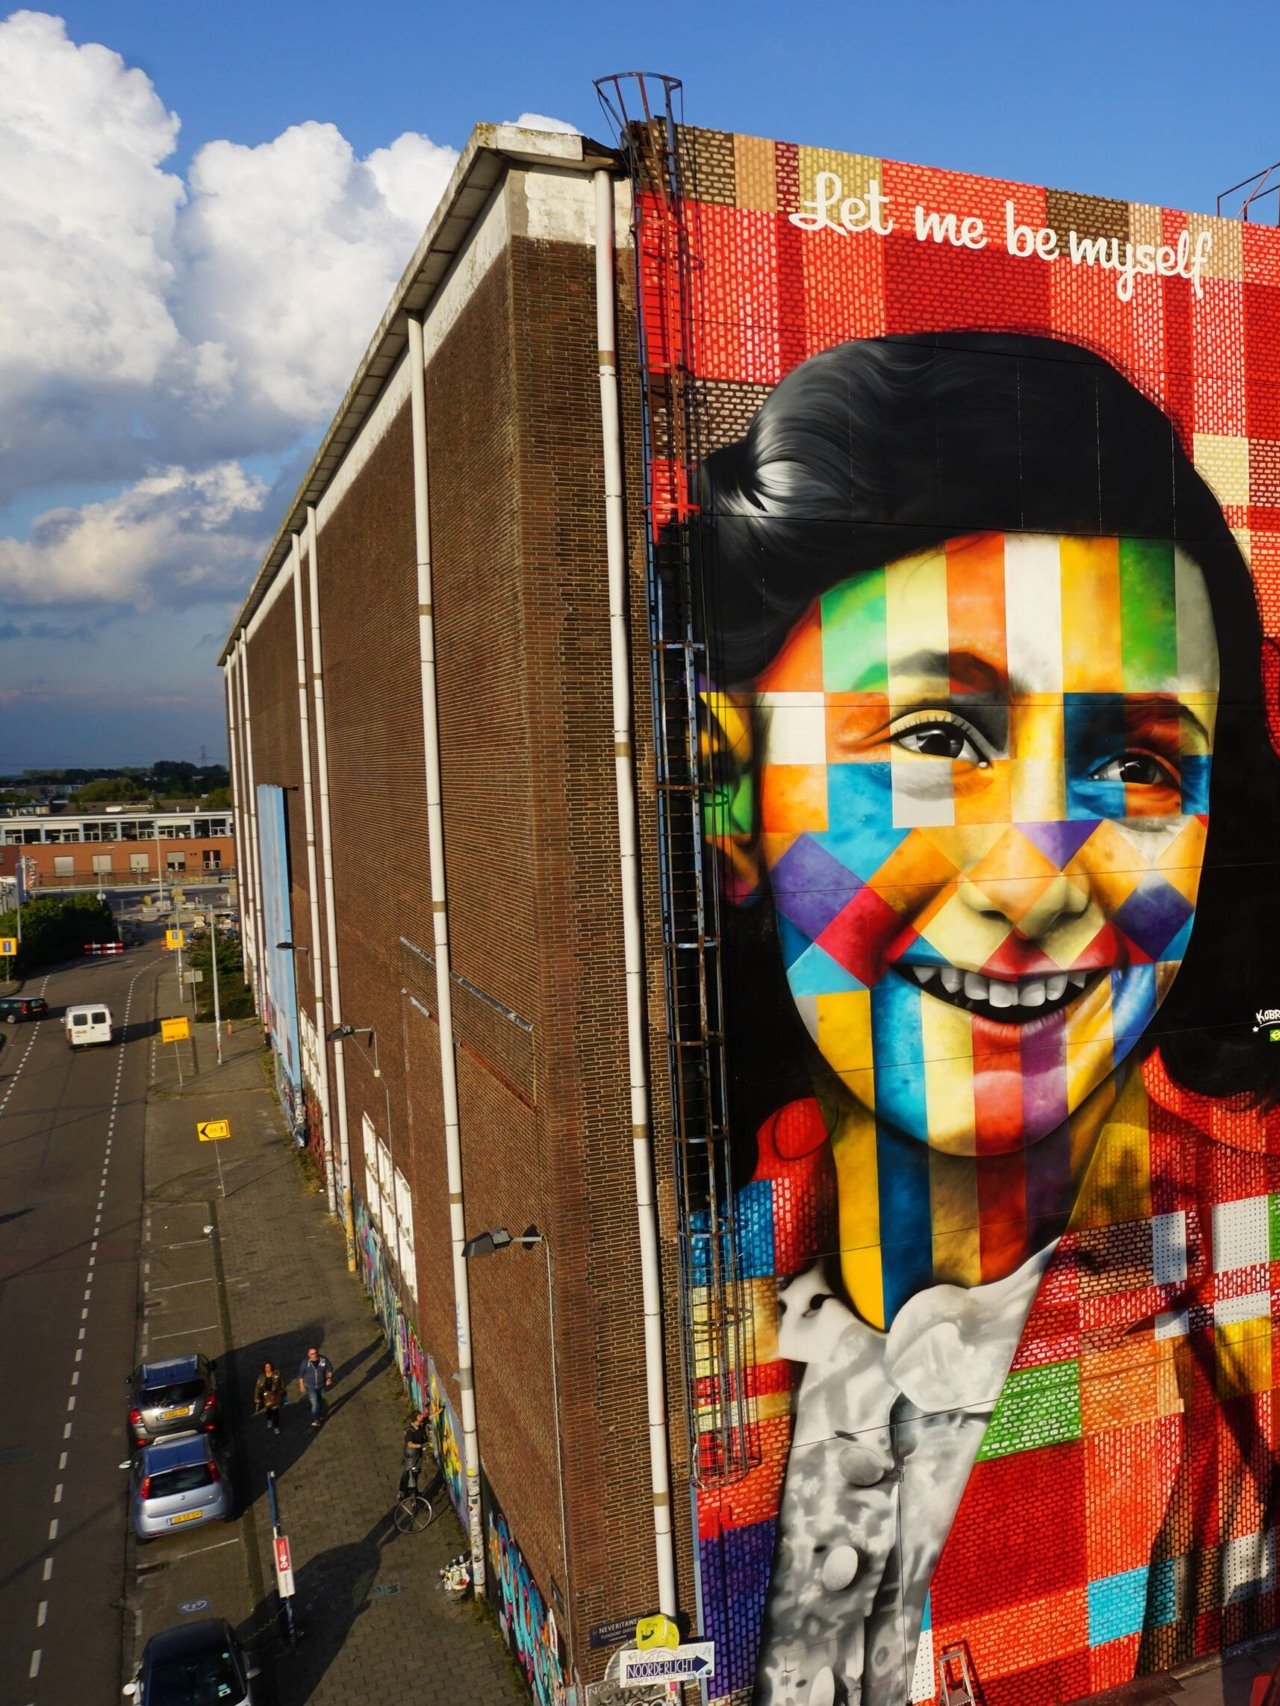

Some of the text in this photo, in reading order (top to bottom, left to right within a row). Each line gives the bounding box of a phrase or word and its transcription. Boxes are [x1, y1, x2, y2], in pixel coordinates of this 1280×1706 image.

[788, 171, 1213, 302] Let me be myself
[626, 1658, 694, 1680] NOORDERLICHT
